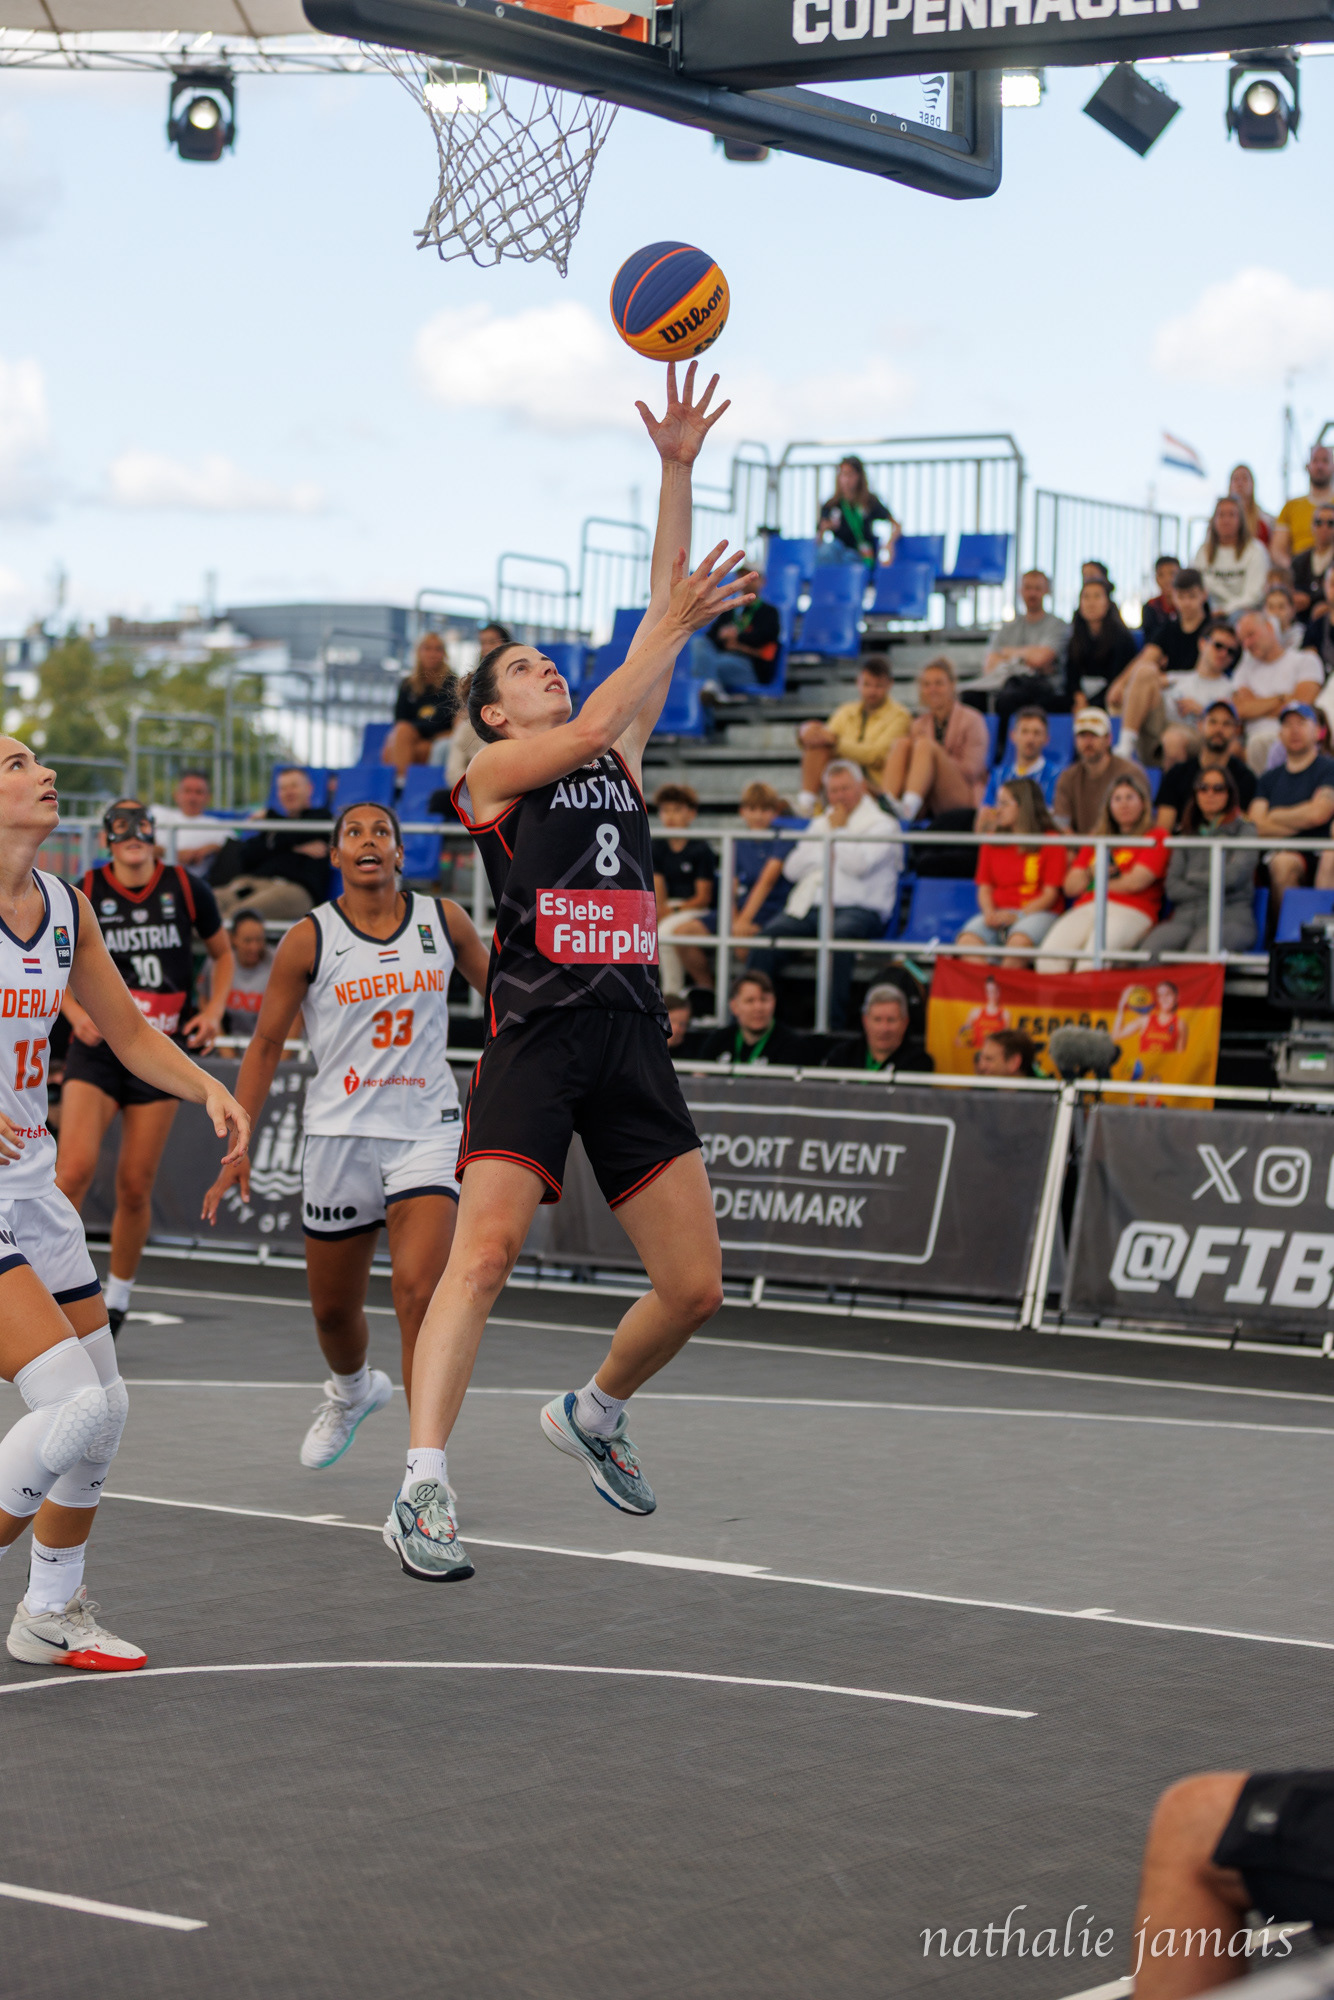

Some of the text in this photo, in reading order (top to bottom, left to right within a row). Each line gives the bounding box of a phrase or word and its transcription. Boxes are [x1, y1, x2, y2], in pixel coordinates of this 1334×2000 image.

[792, 0, 1200, 45] COPENH
[658, 284, 724, 344] Wilson
[595, 823, 621, 877] 8
[539, 892, 614, 921] Es lebe
[104, 924, 182, 952] AUSTRIA
[553, 923, 656, 961] Fairplay
[130, 954, 163, 988] 10
[334, 969, 445, 1006] NEDERLAND
[0, 988, 64, 1018] DERLA
[371, 1008, 415, 1049] 33
[13, 1038, 48, 1091] 15
[700, 1133, 907, 1177] SPORT EVENT
[712, 1186, 867, 1228] DENMARK
[1108, 1220, 1334, 1310] @FIB
